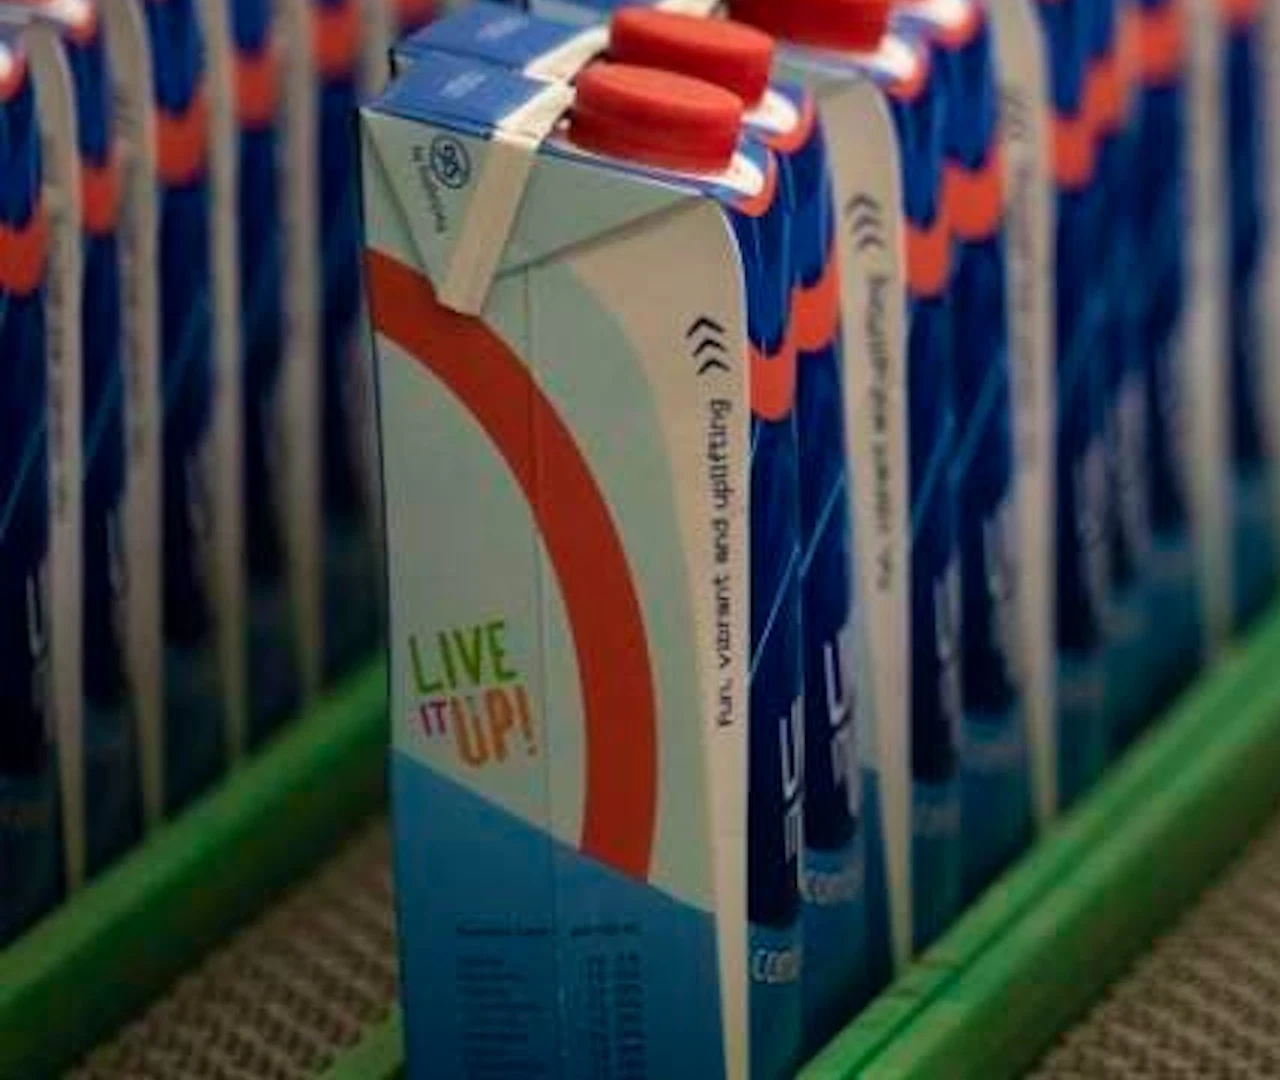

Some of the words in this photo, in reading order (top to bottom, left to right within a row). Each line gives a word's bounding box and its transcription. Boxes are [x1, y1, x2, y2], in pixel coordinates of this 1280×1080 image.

[705, 398, 735, 511] uplifting
[710, 517, 730, 565] and
[408, 620, 518, 694] LIVE
[711, 574, 732, 670] vibrant
[419, 699, 448, 738] IT
[450, 684, 539, 769] UP!
